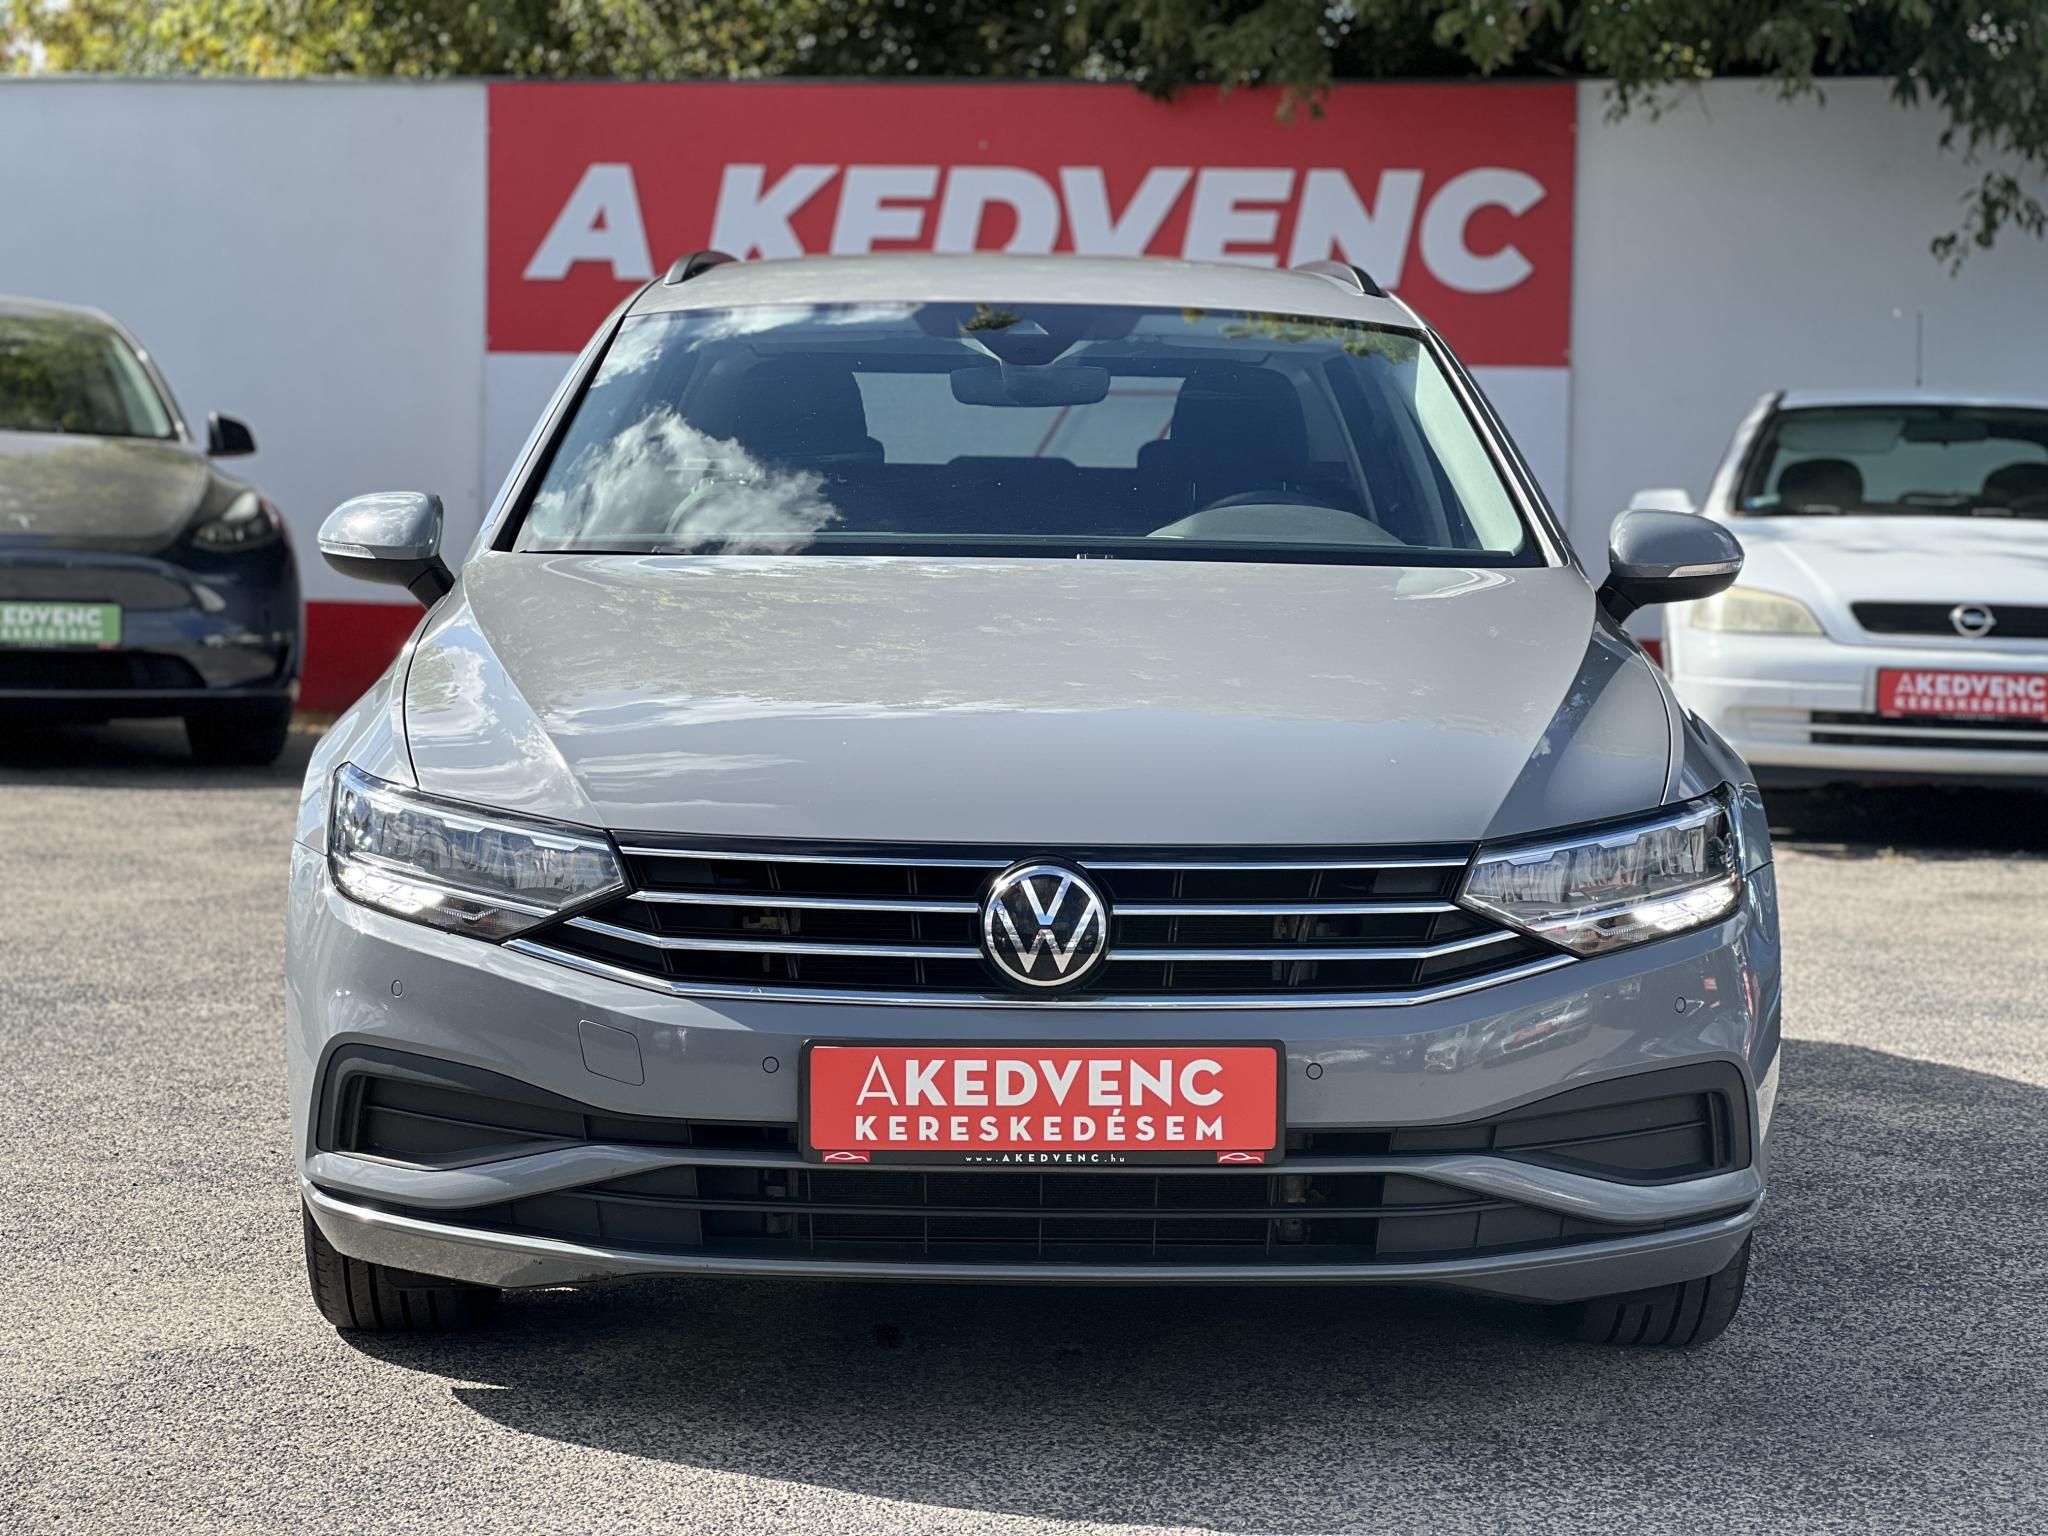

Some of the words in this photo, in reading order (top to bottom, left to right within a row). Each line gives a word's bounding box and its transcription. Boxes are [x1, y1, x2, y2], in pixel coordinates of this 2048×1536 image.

[522, 162, 656, 281] A
[708, 163, 1548, 295] KEDVENC
[855, 1055, 1224, 1107] AKEDVENC
[855, 1108, 1224, 1142] KERESKEDÉSEM
